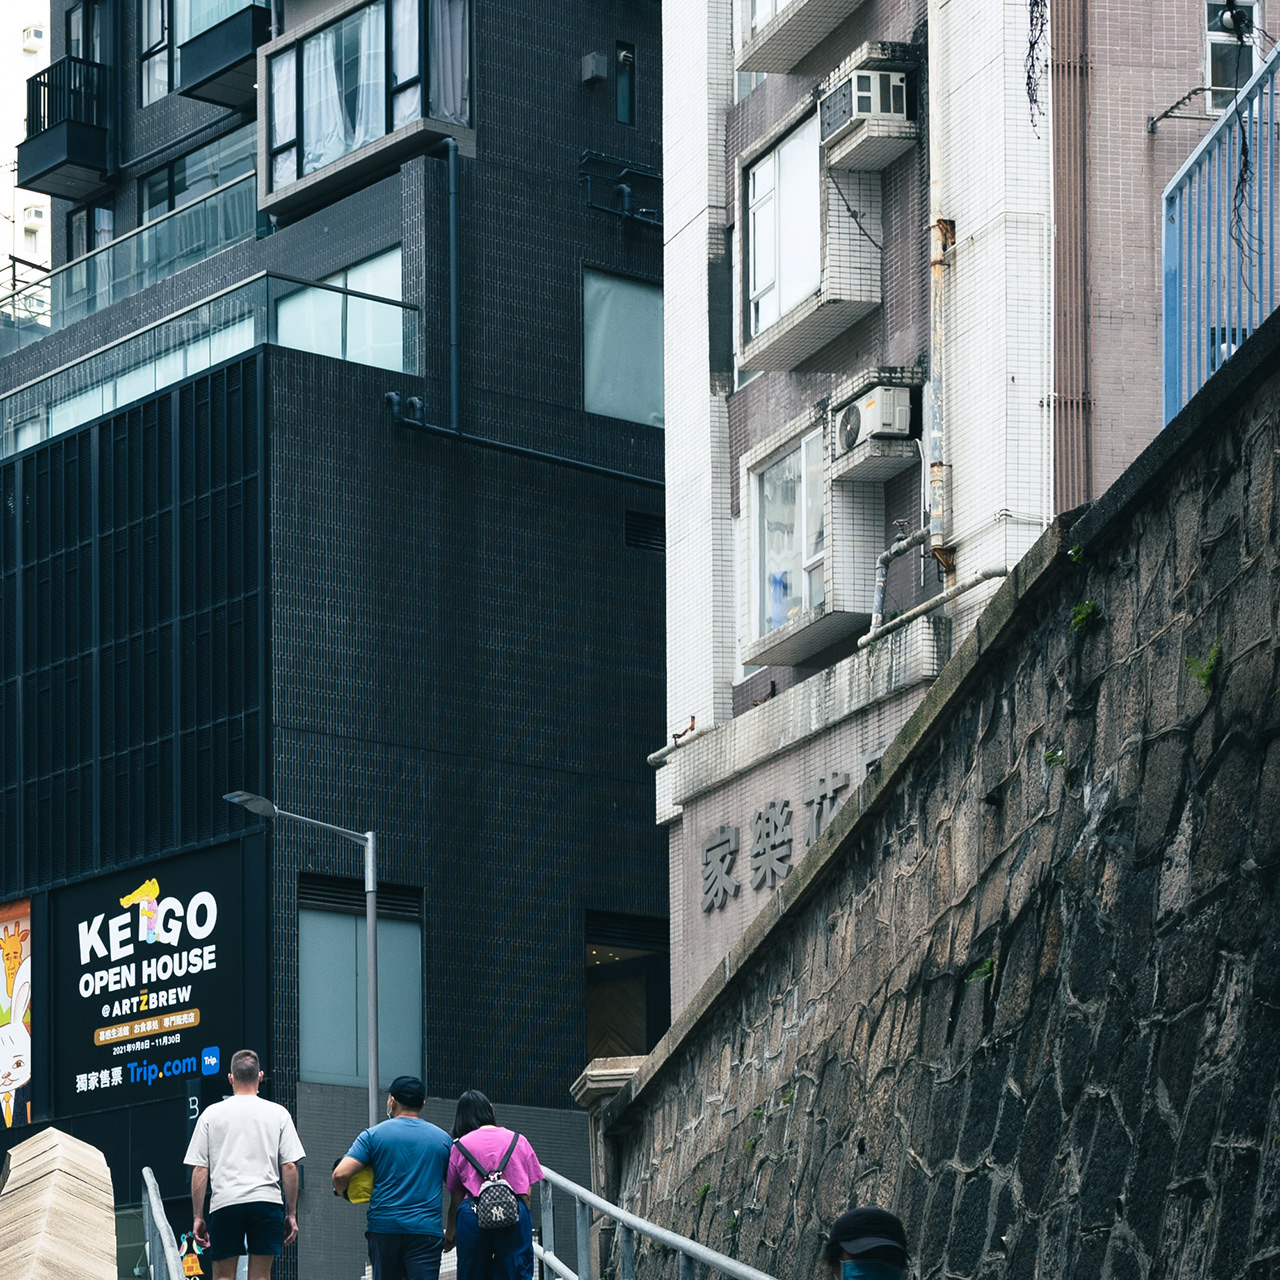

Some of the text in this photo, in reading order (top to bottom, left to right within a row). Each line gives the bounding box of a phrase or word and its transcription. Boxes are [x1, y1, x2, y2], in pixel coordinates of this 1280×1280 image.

[701, 755, 883, 913] 家樂花
[78, 891, 218, 966] KEIGO
[78, 945, 217, 998] OPEN HOUSE
[75, 1055, 197, 1094] 獨家售票 Trip.com
